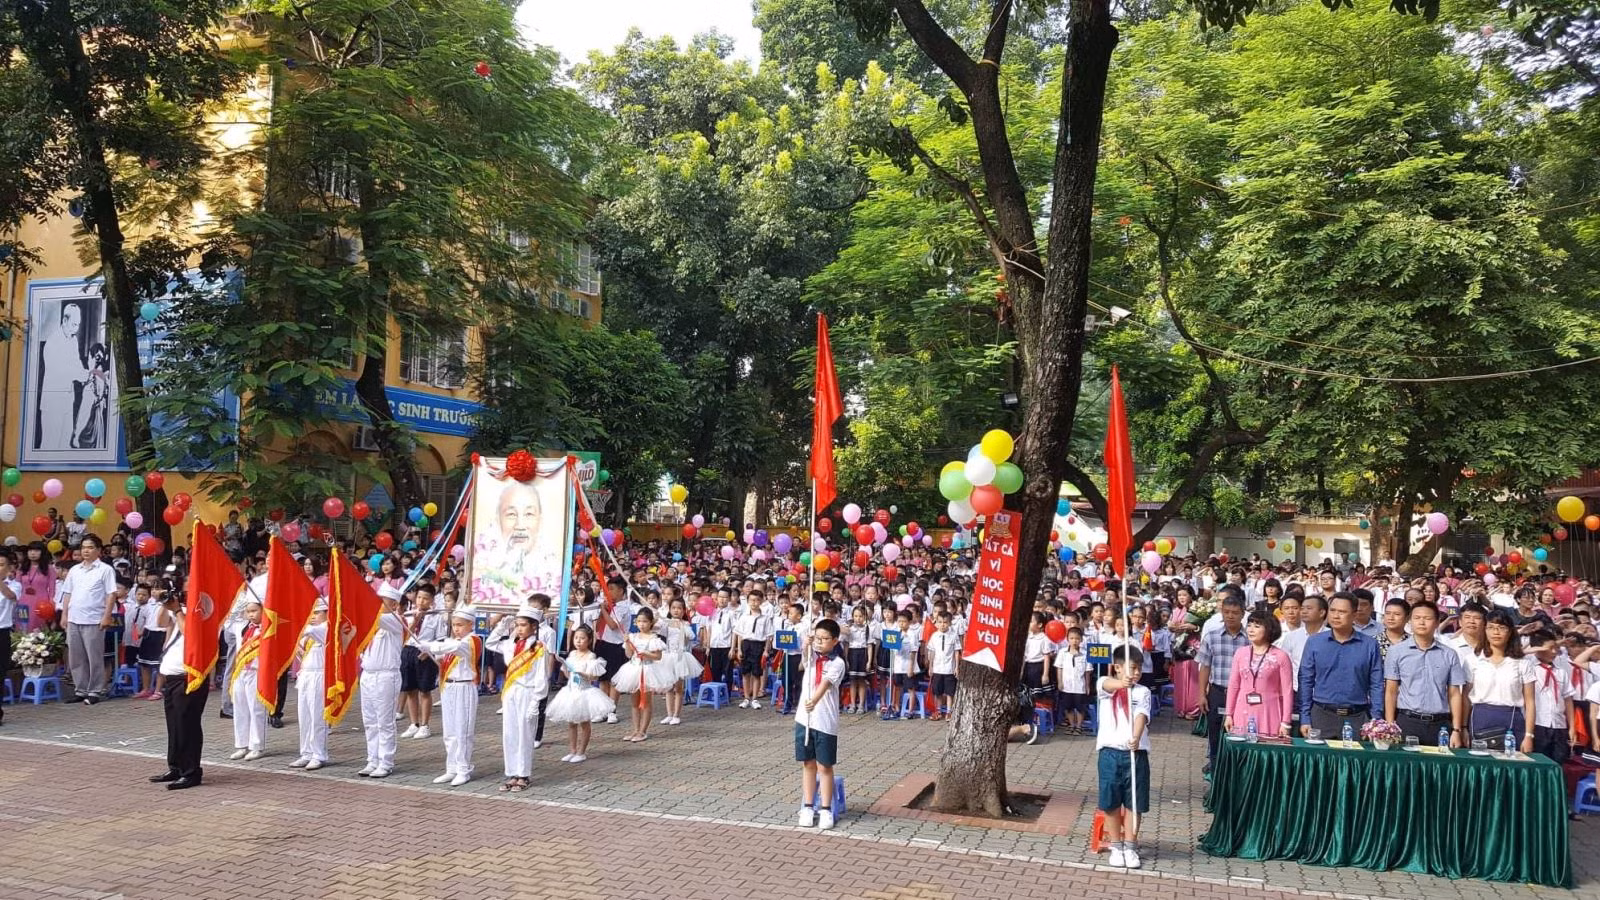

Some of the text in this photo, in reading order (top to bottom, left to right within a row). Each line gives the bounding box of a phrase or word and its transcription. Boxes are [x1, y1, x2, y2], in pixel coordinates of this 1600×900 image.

[398, 402, 431, 420] SINH
[433, 407, 481, 427] TRƯỜN
[1001, 542, 1014, 557] CẢ
[982, 575, 1004, 592] HỌC
[980, 594, 1003, 610] SINH
[977, 610, 1005, 628] THÂN
[977, 630, 1000, 645] YÊU
